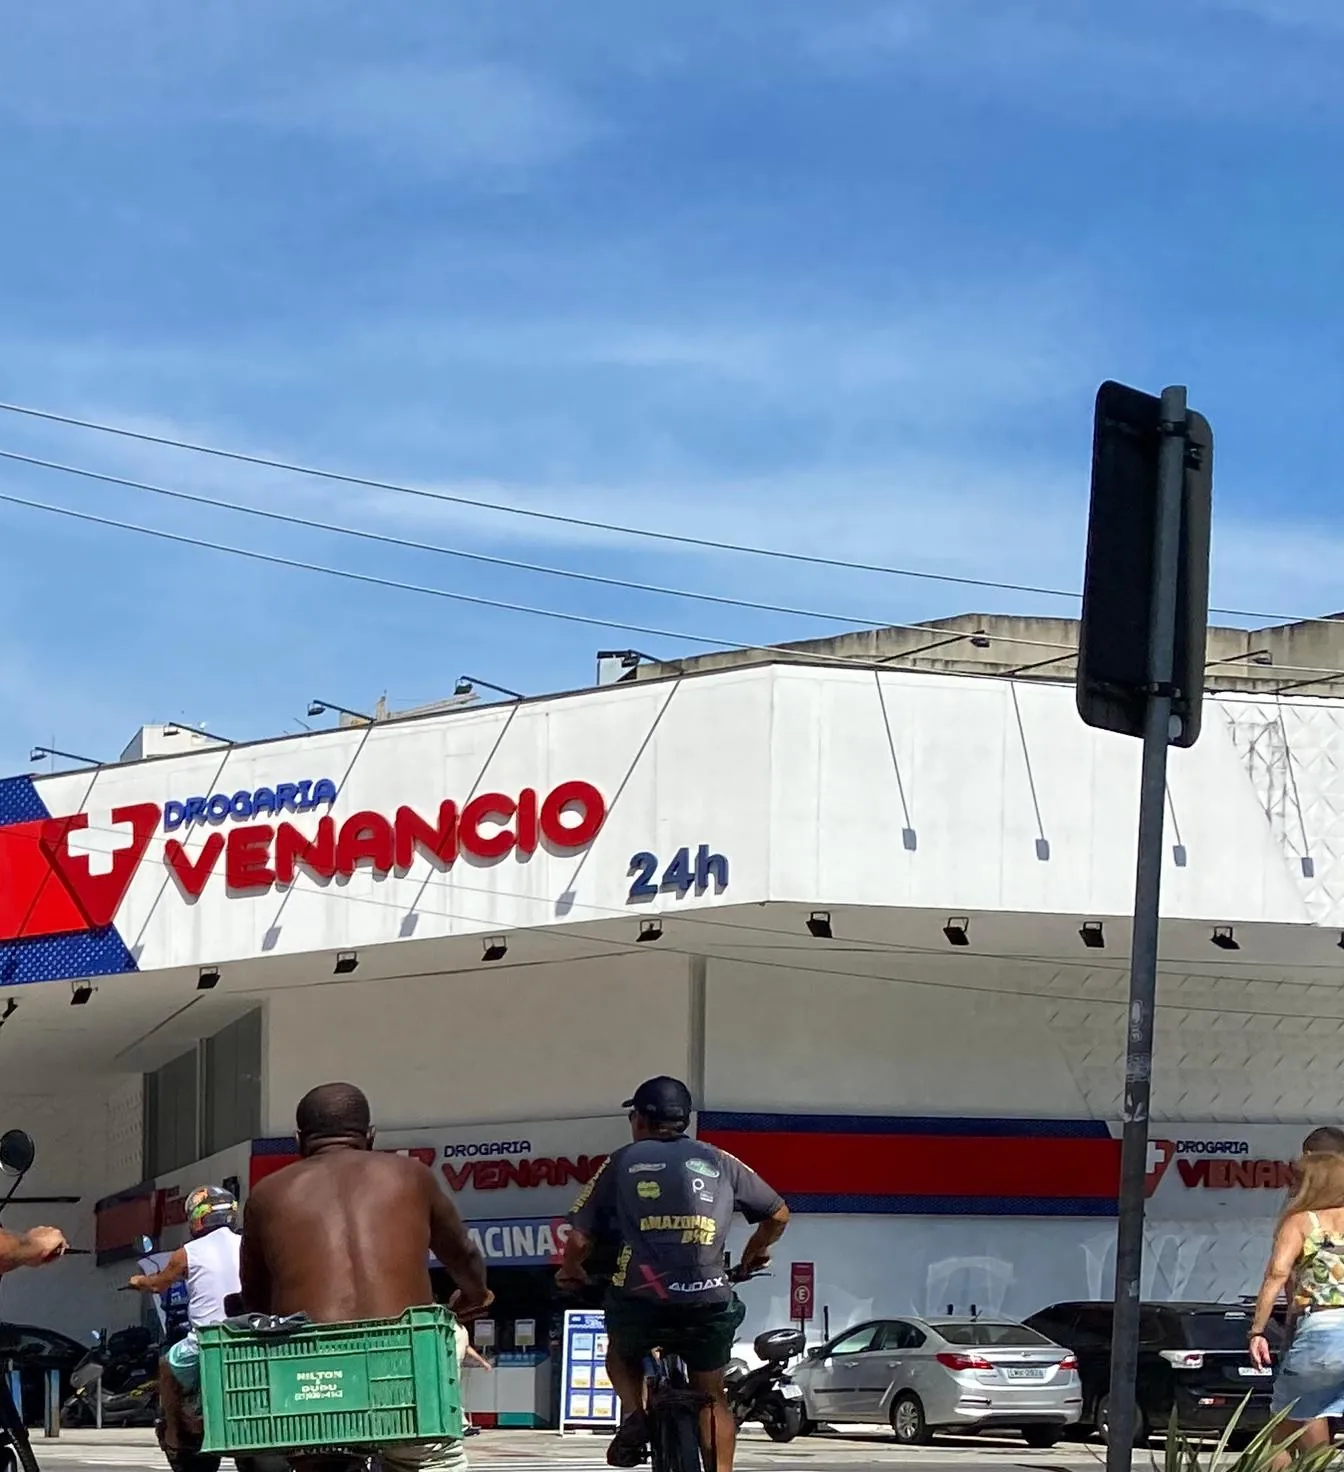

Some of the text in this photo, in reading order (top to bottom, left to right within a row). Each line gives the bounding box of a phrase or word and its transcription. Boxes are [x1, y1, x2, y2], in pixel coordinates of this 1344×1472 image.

[164, 778, 338, 832] DROGARIA
[164, 780, 607, 903] VENANCIO
[628, 844, 728, 902] 24h
[443, 1140, 532, 1158] DROGARIA
[1175, 1140, 1249, 1155] DROGARIA
[640, 1214, 717, 1232] AMAZONAS
[465, 1223, 573, 1259] ACINAS
[680, 1229, 716, 1246] BIKE
[668, 1276, 724, 1293] AUDAX
